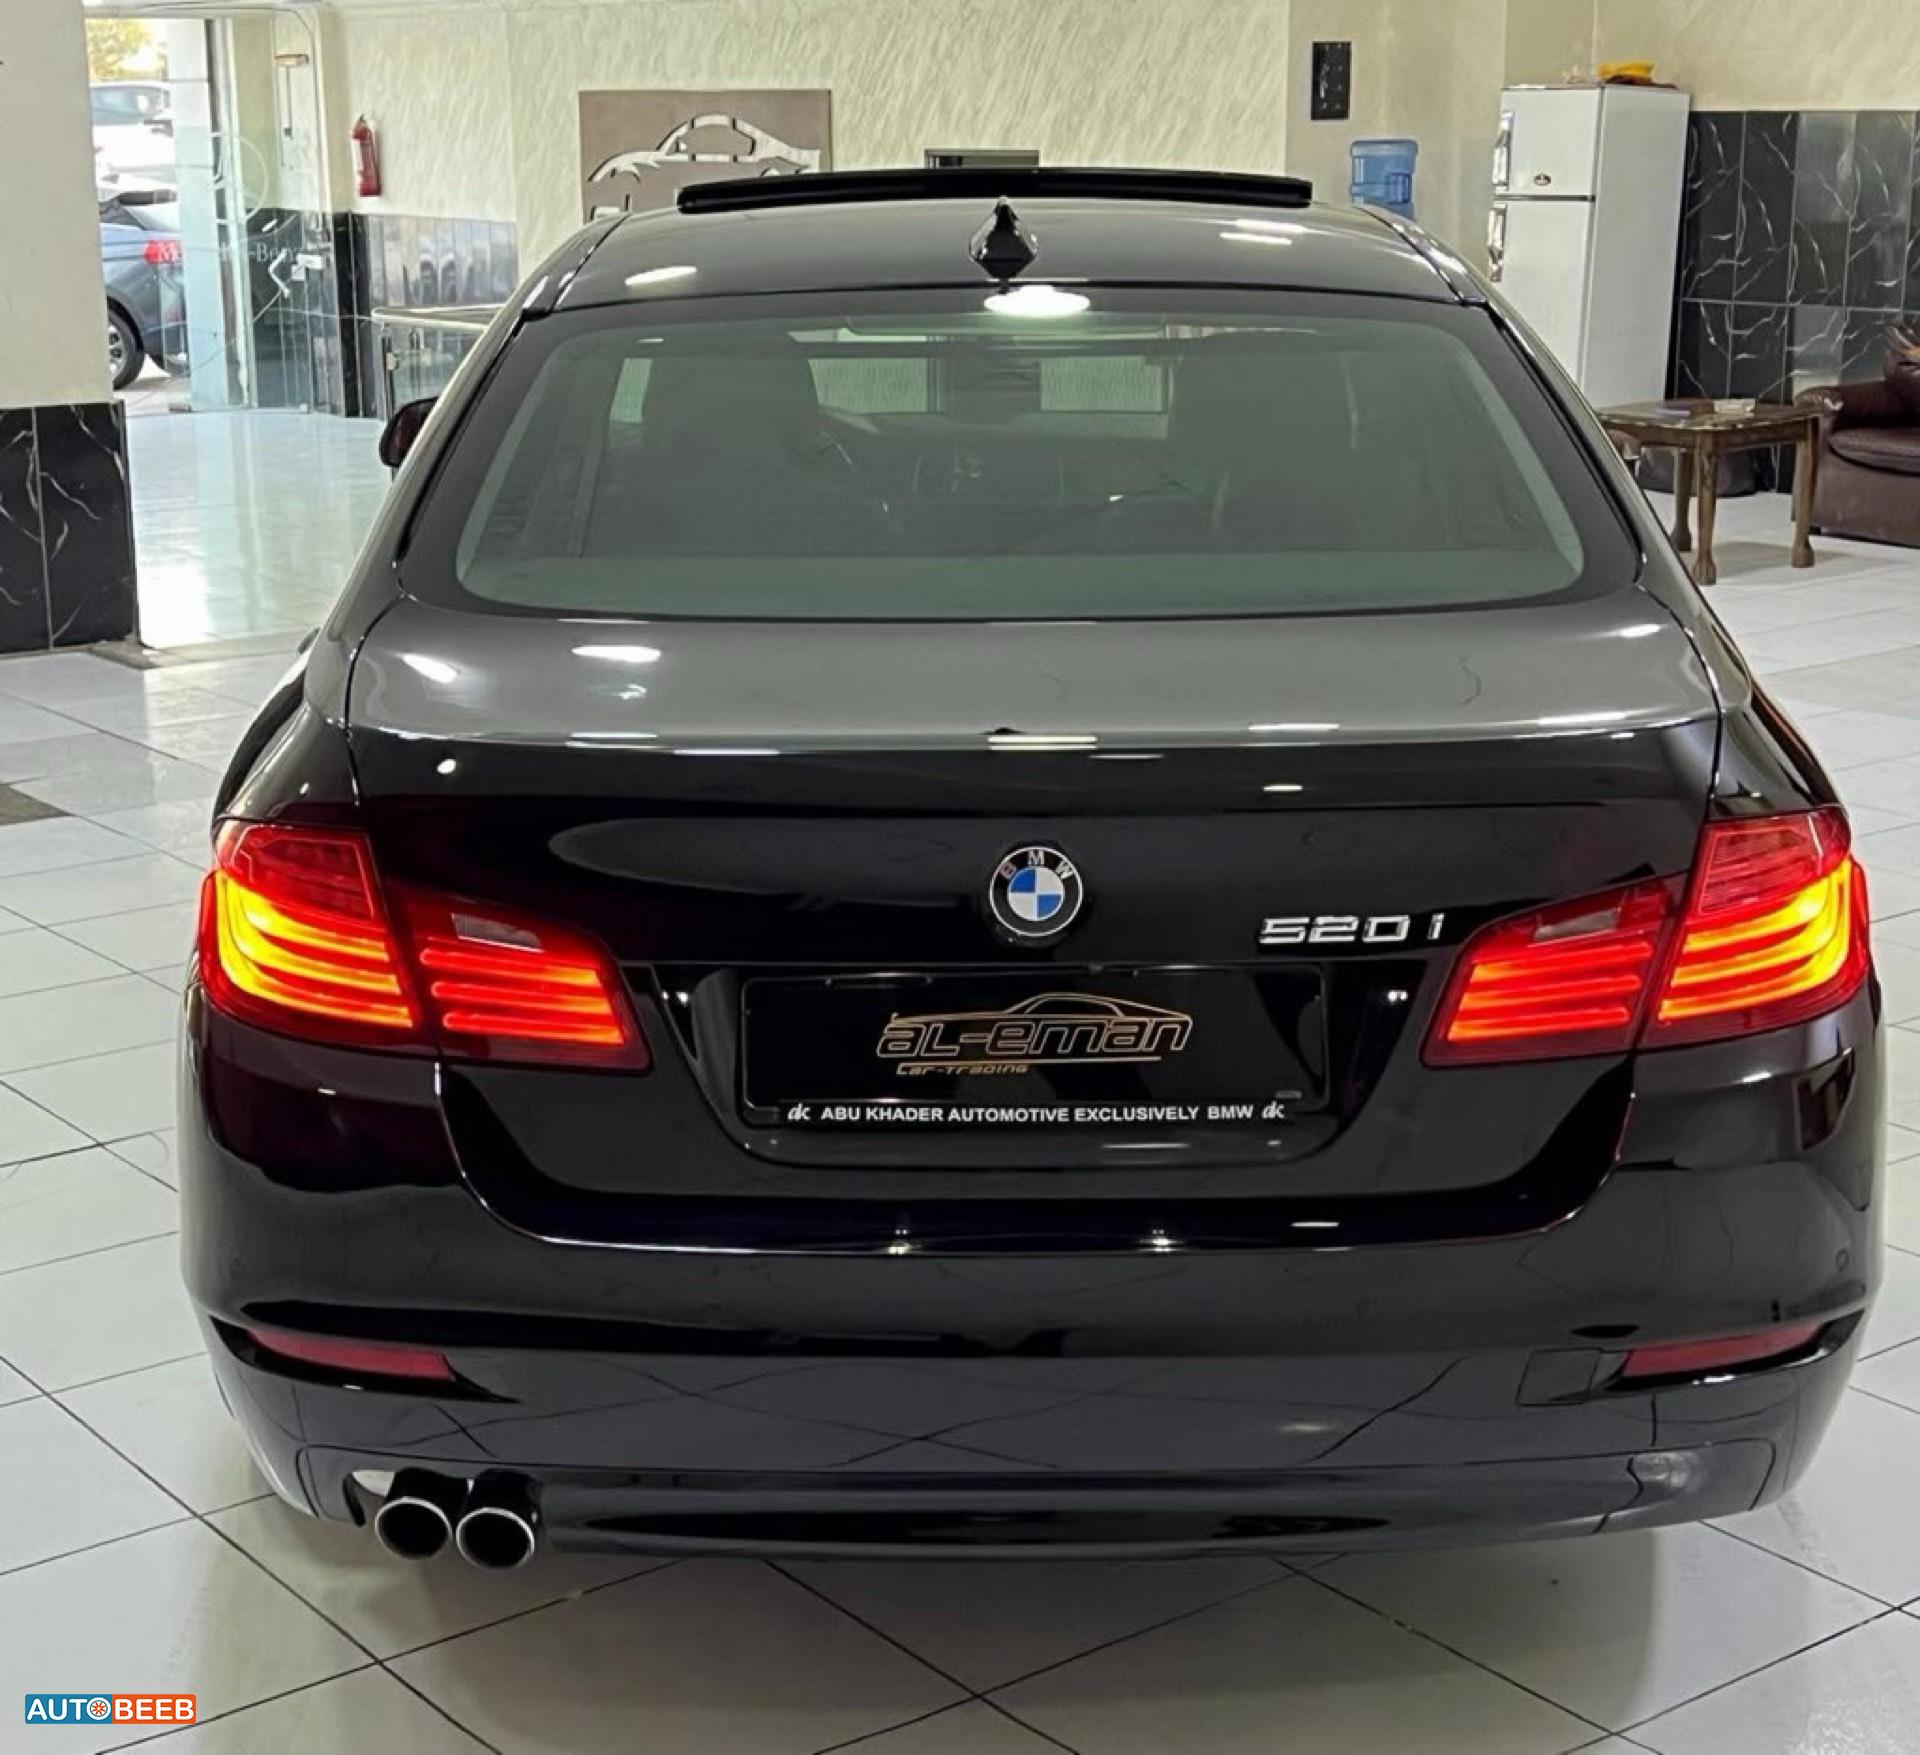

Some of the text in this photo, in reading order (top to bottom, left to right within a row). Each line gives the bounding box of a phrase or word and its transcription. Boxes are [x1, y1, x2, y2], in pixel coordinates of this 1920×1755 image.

[1000, 849, 1075, 880] BMW
[820, 1106, 860, 1121] ABU
[865, 1107, 944, 1122] KHADER
[948, 1107, 1070, 1123] AUTOMOTIVE
[1074, 1105, 1199, 1122] EXCLUSIVELY
[1207, 1104, 1254, 1121] BMW
